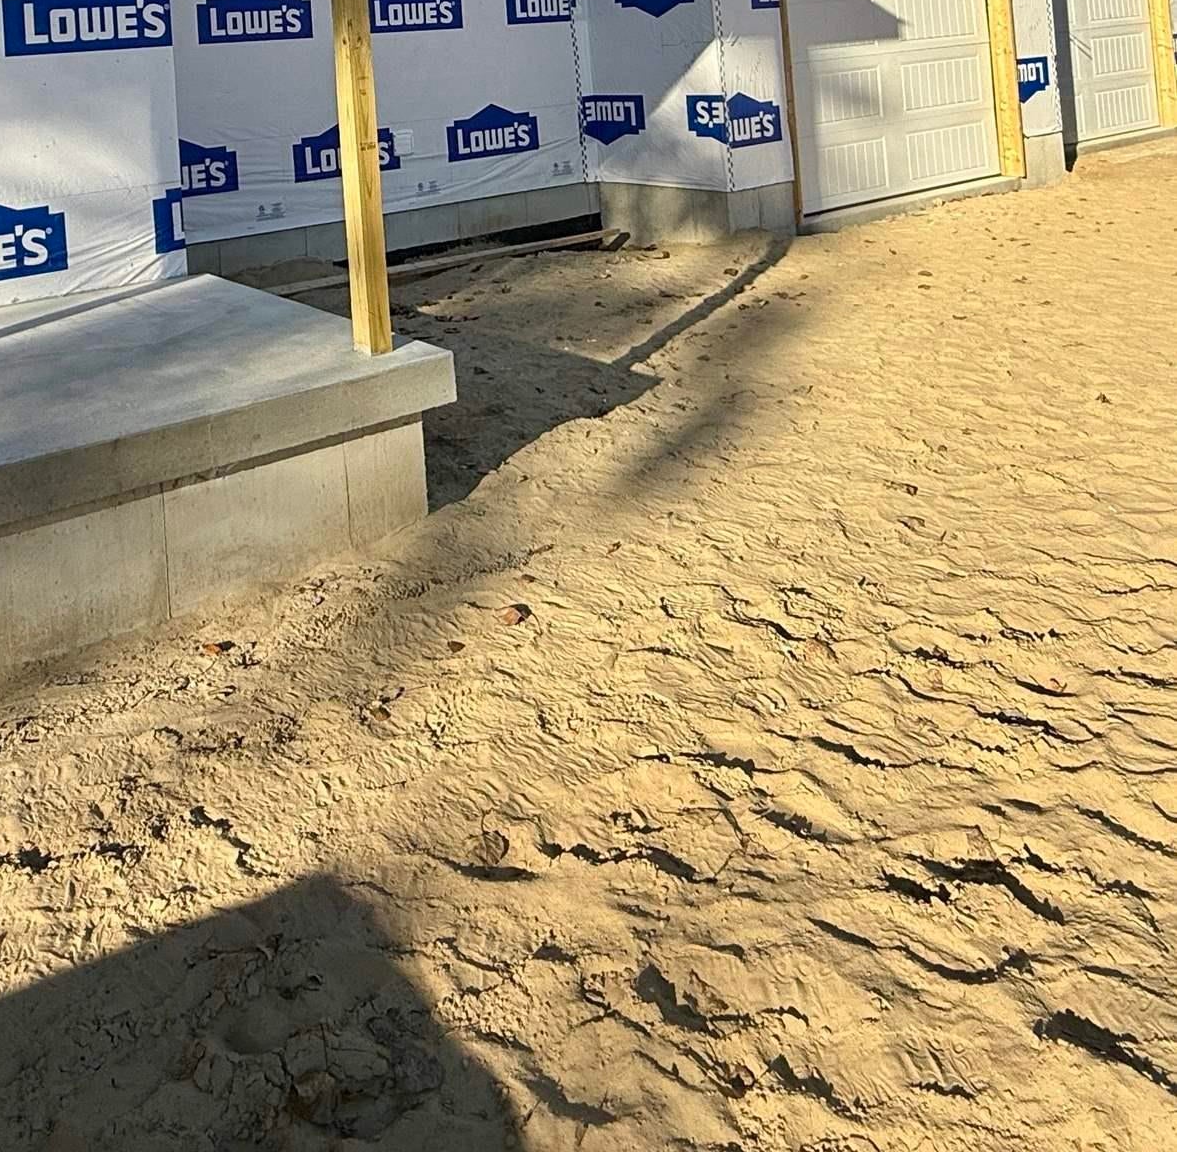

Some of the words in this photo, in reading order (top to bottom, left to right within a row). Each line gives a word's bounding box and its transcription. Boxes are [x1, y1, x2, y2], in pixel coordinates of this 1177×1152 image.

[23, 0, 166, 42] LOWE'S
[210, 4, 301, 36] LOWE'S
[457, 122, 530, 154] LOWE'S
